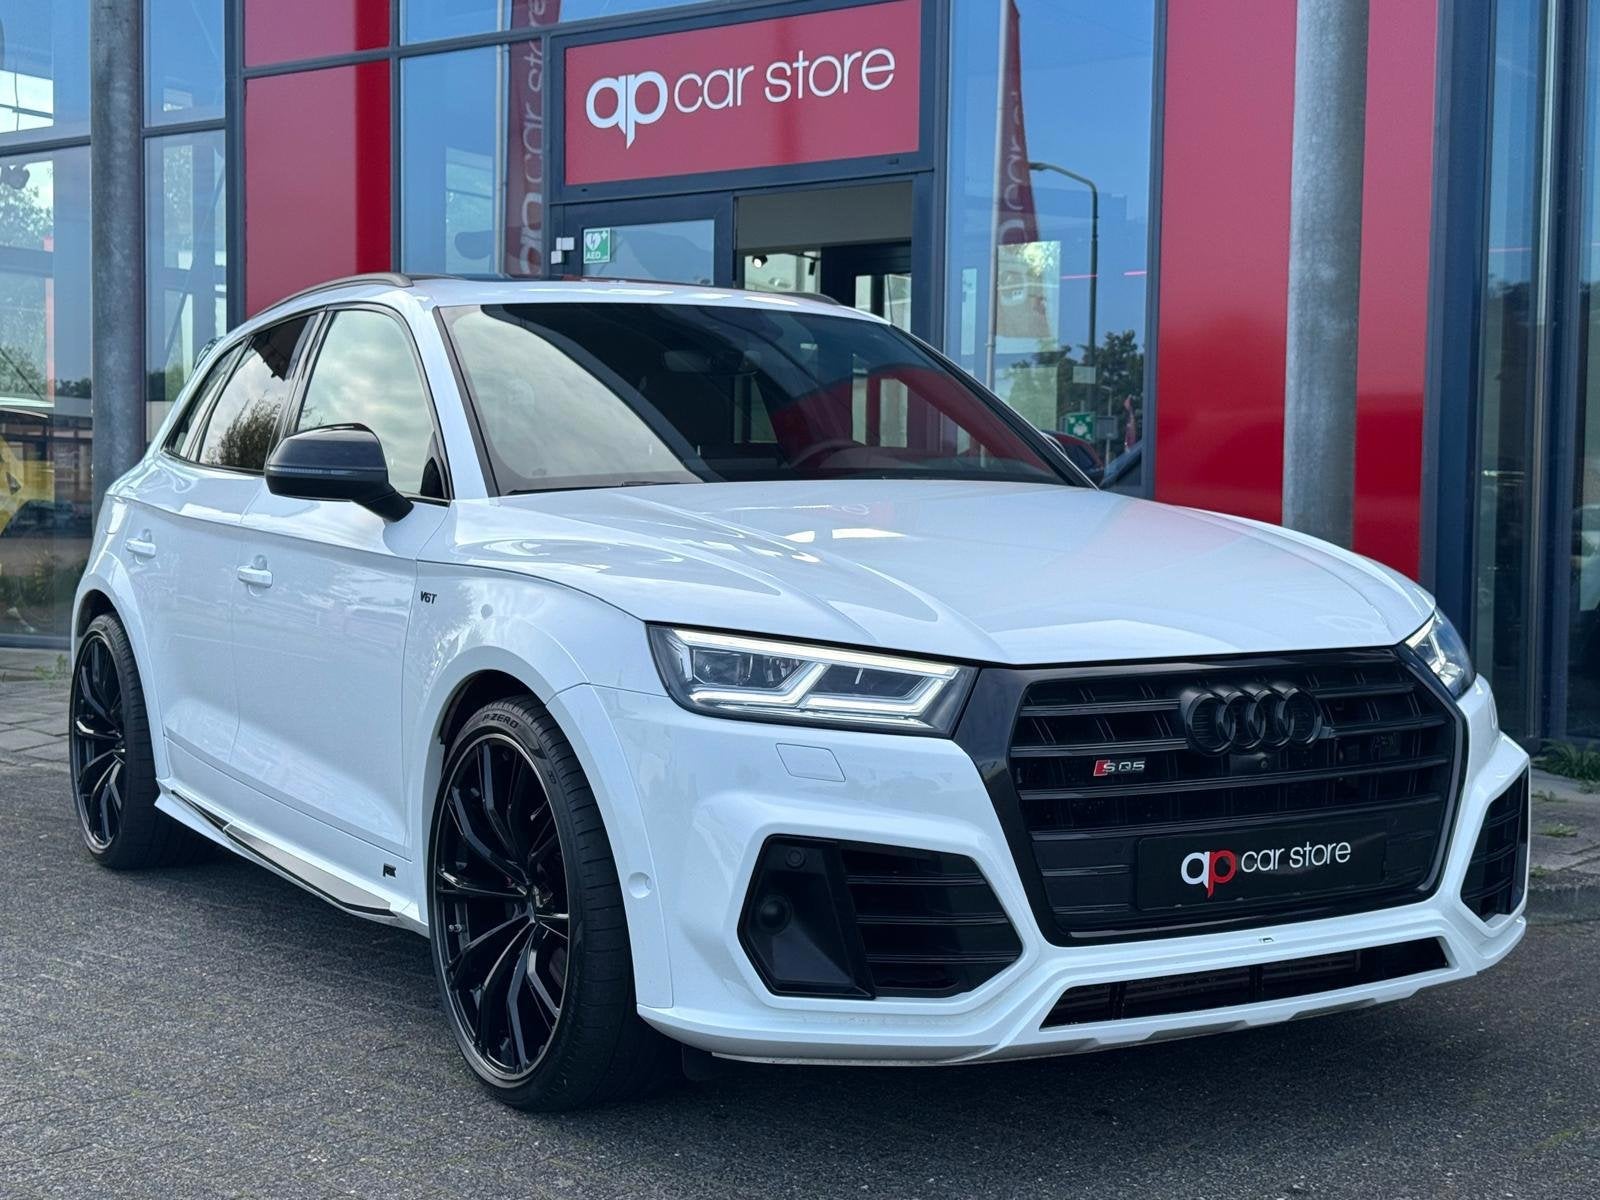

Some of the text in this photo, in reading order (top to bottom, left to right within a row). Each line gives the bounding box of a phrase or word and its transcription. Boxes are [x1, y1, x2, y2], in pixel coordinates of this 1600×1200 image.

[586, 47, 896, 149] ap car store
[420, 590, 438, 605] V6T
[1102, 760, 1146, 773] SQ5
[1180, 841, 1352, 899] ap car store
